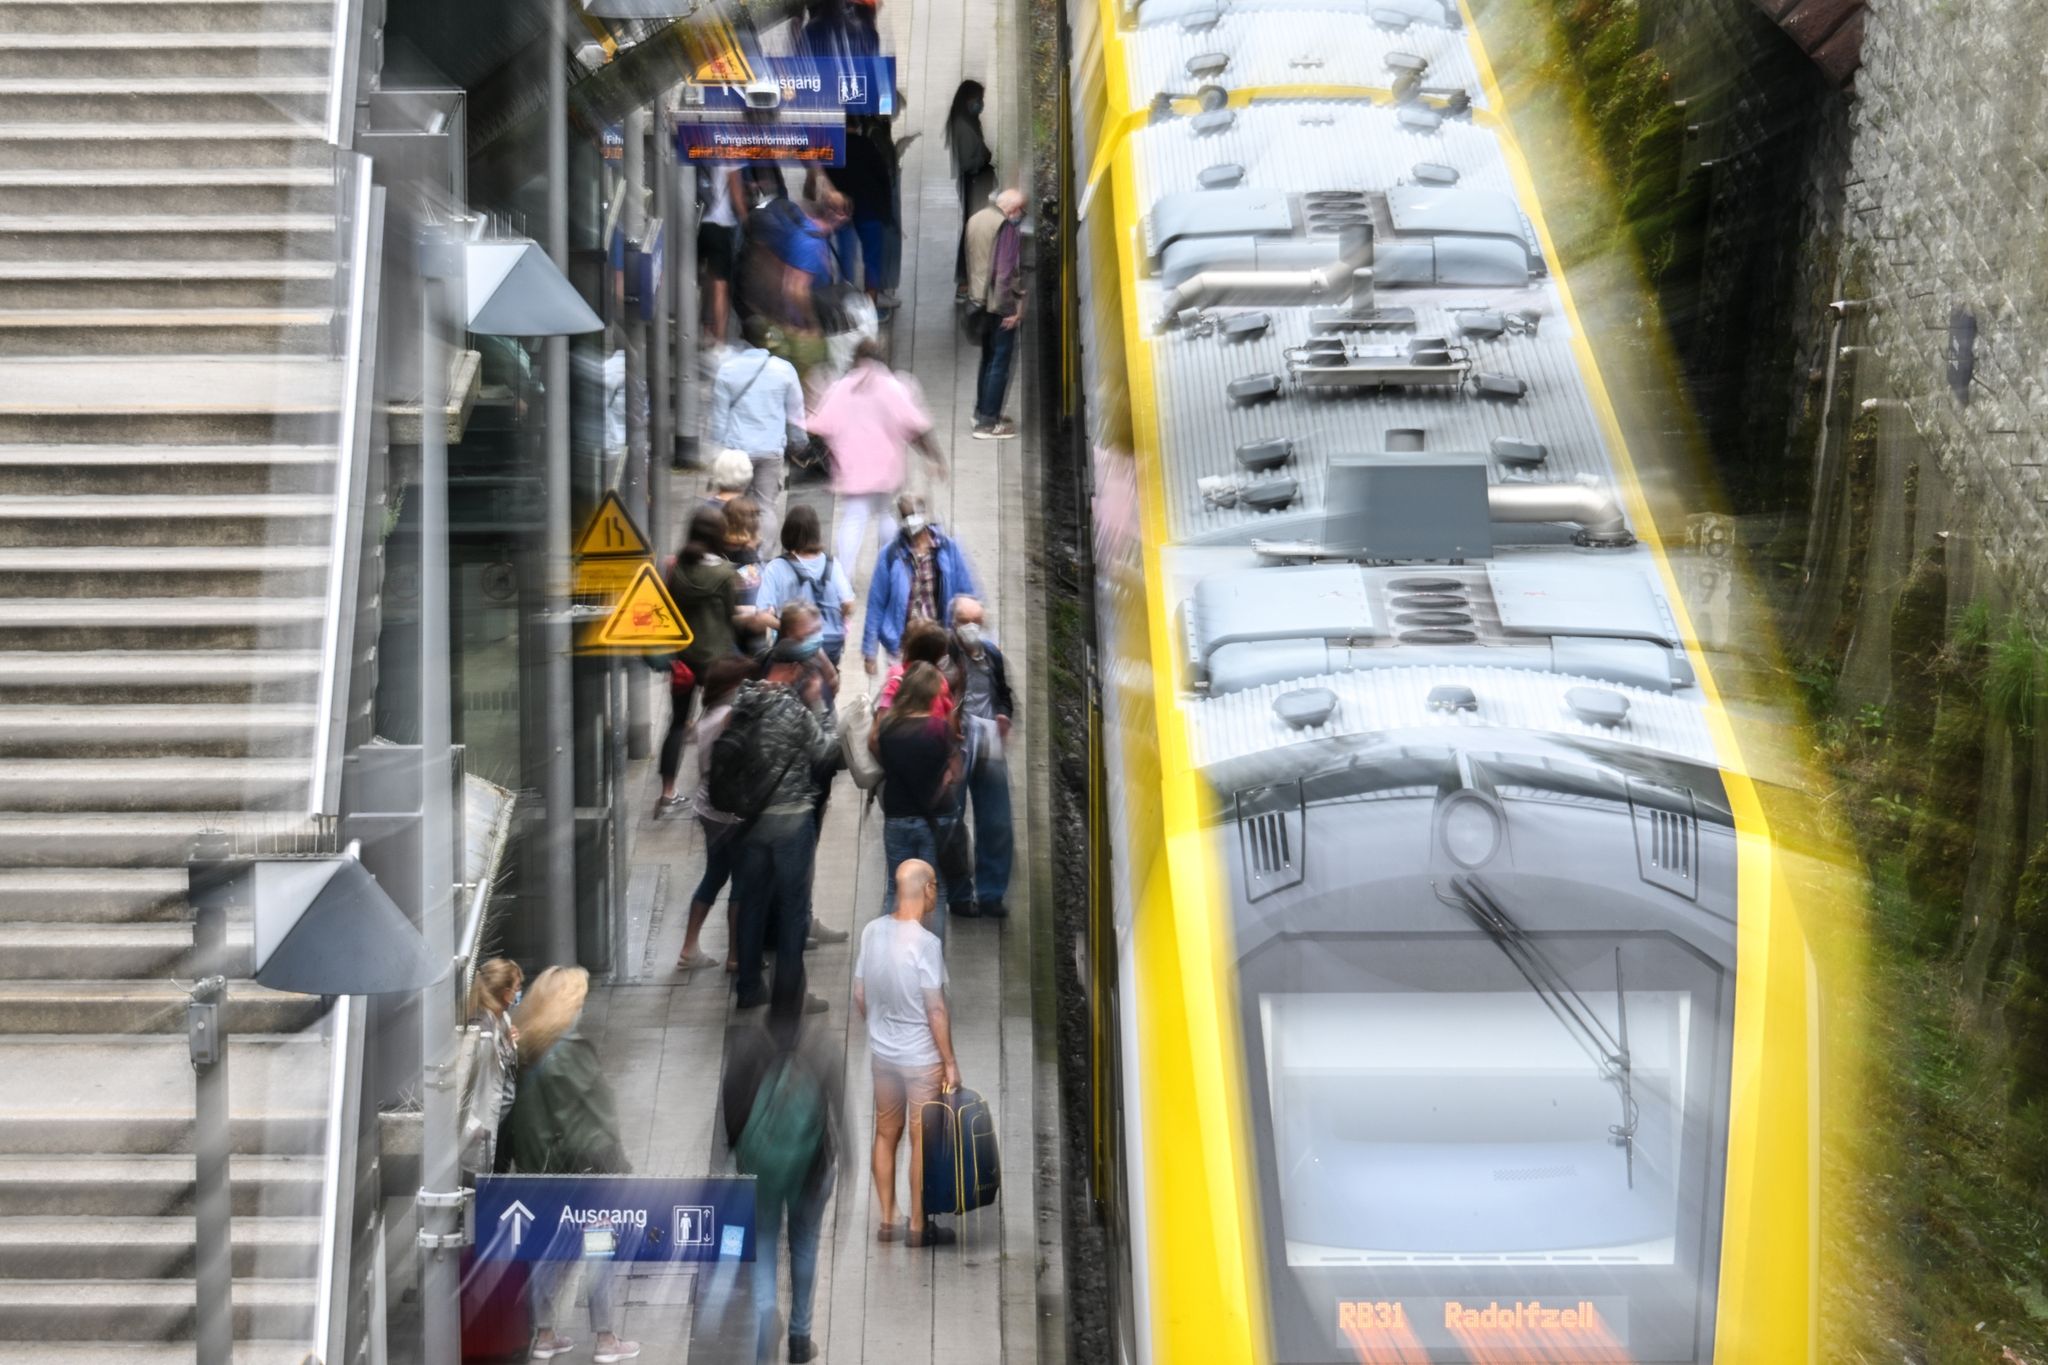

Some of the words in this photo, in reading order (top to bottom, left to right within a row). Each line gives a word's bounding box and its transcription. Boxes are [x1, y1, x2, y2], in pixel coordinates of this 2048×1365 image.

[758, 75, 821, 92] sgang
[714, 134, 809, 147] Fahrgastinformation
[1339, 1302, 1402, 1328] RB31
[1445, 1302, 1594, 1328] Radolfzell
